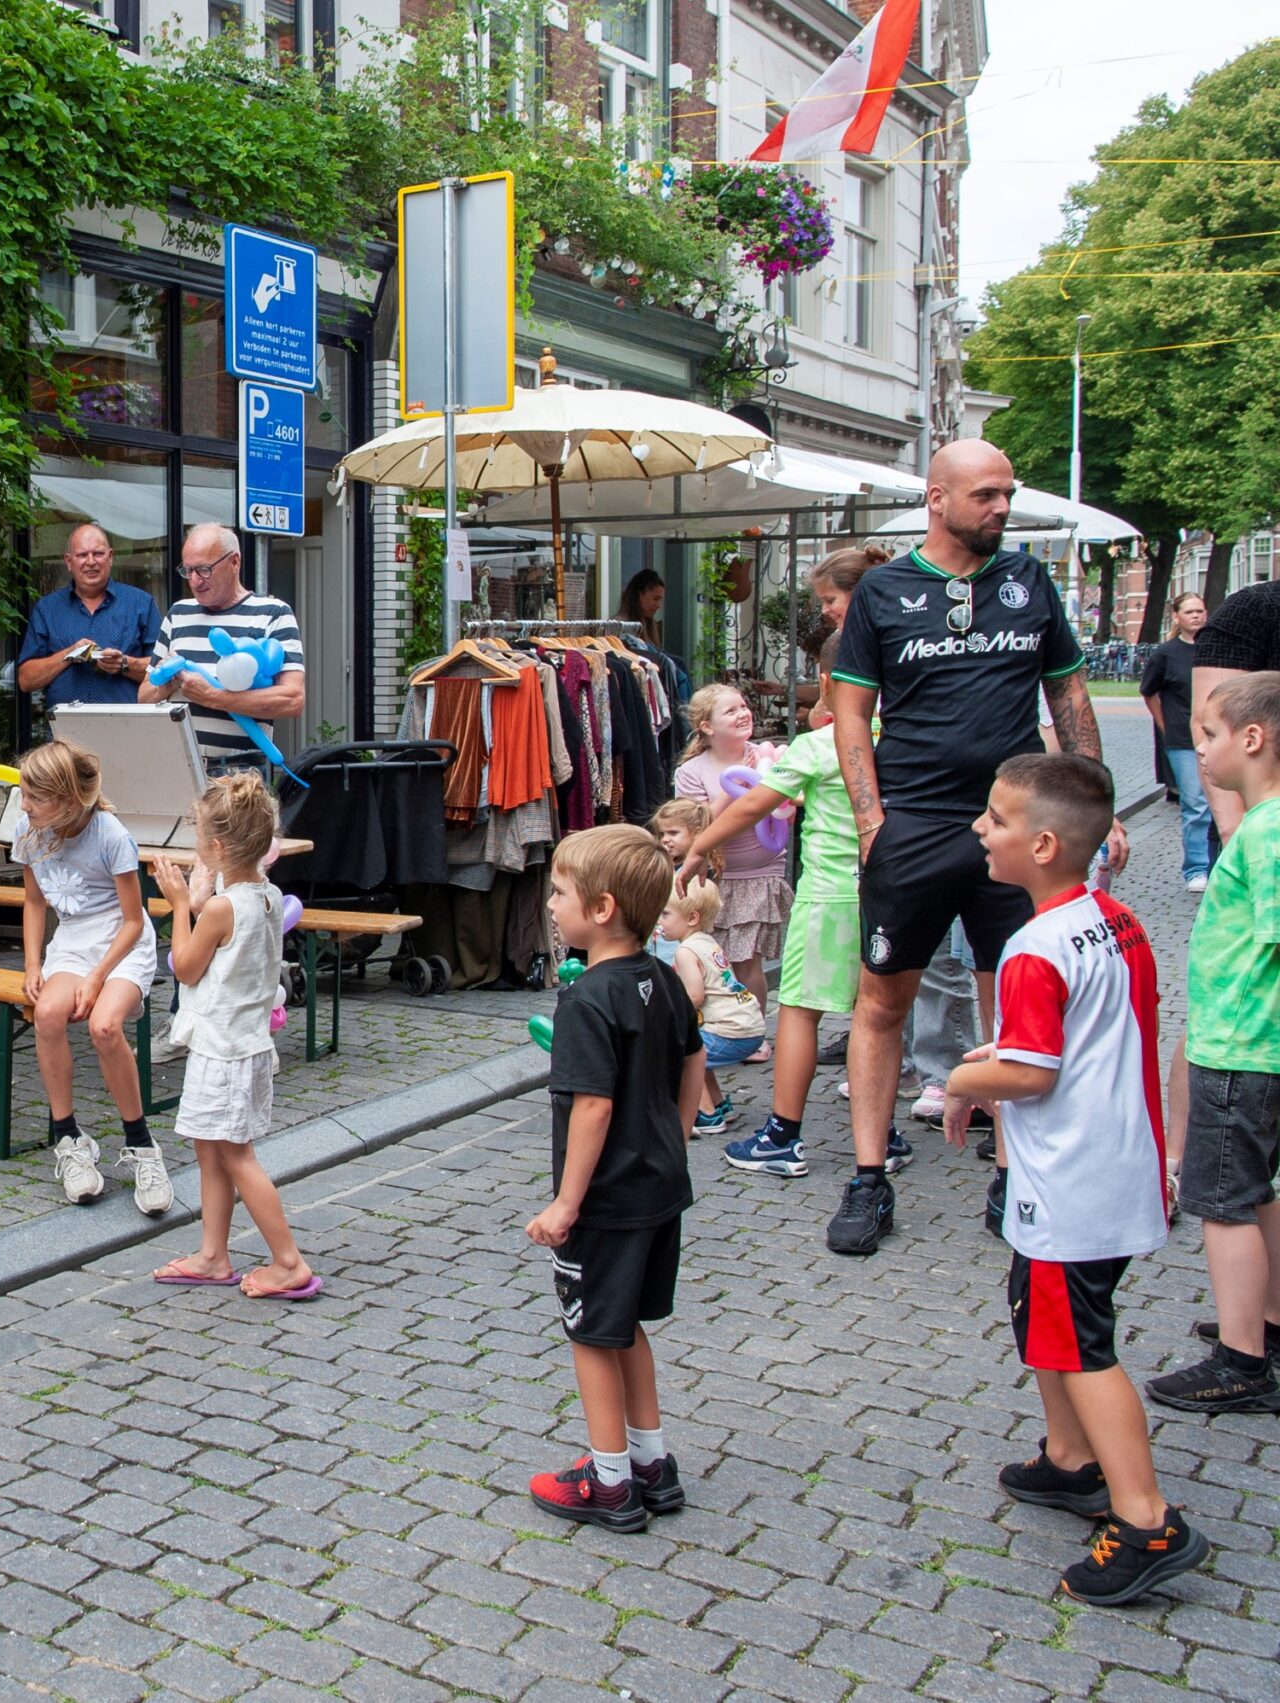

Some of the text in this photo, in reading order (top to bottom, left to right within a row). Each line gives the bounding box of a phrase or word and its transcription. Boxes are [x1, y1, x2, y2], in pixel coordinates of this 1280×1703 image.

[243, 315, 306, 338] Alleen kort parkeren
[251, 330, 299, 348] maximaal 2 uur
[239, 353, 253, 363] voor
[242, 339, 307, 363] Verboden te parkeren
[249, 387, 300, 442] P 4601
[897, 630, 1041, 663] Media Markt
